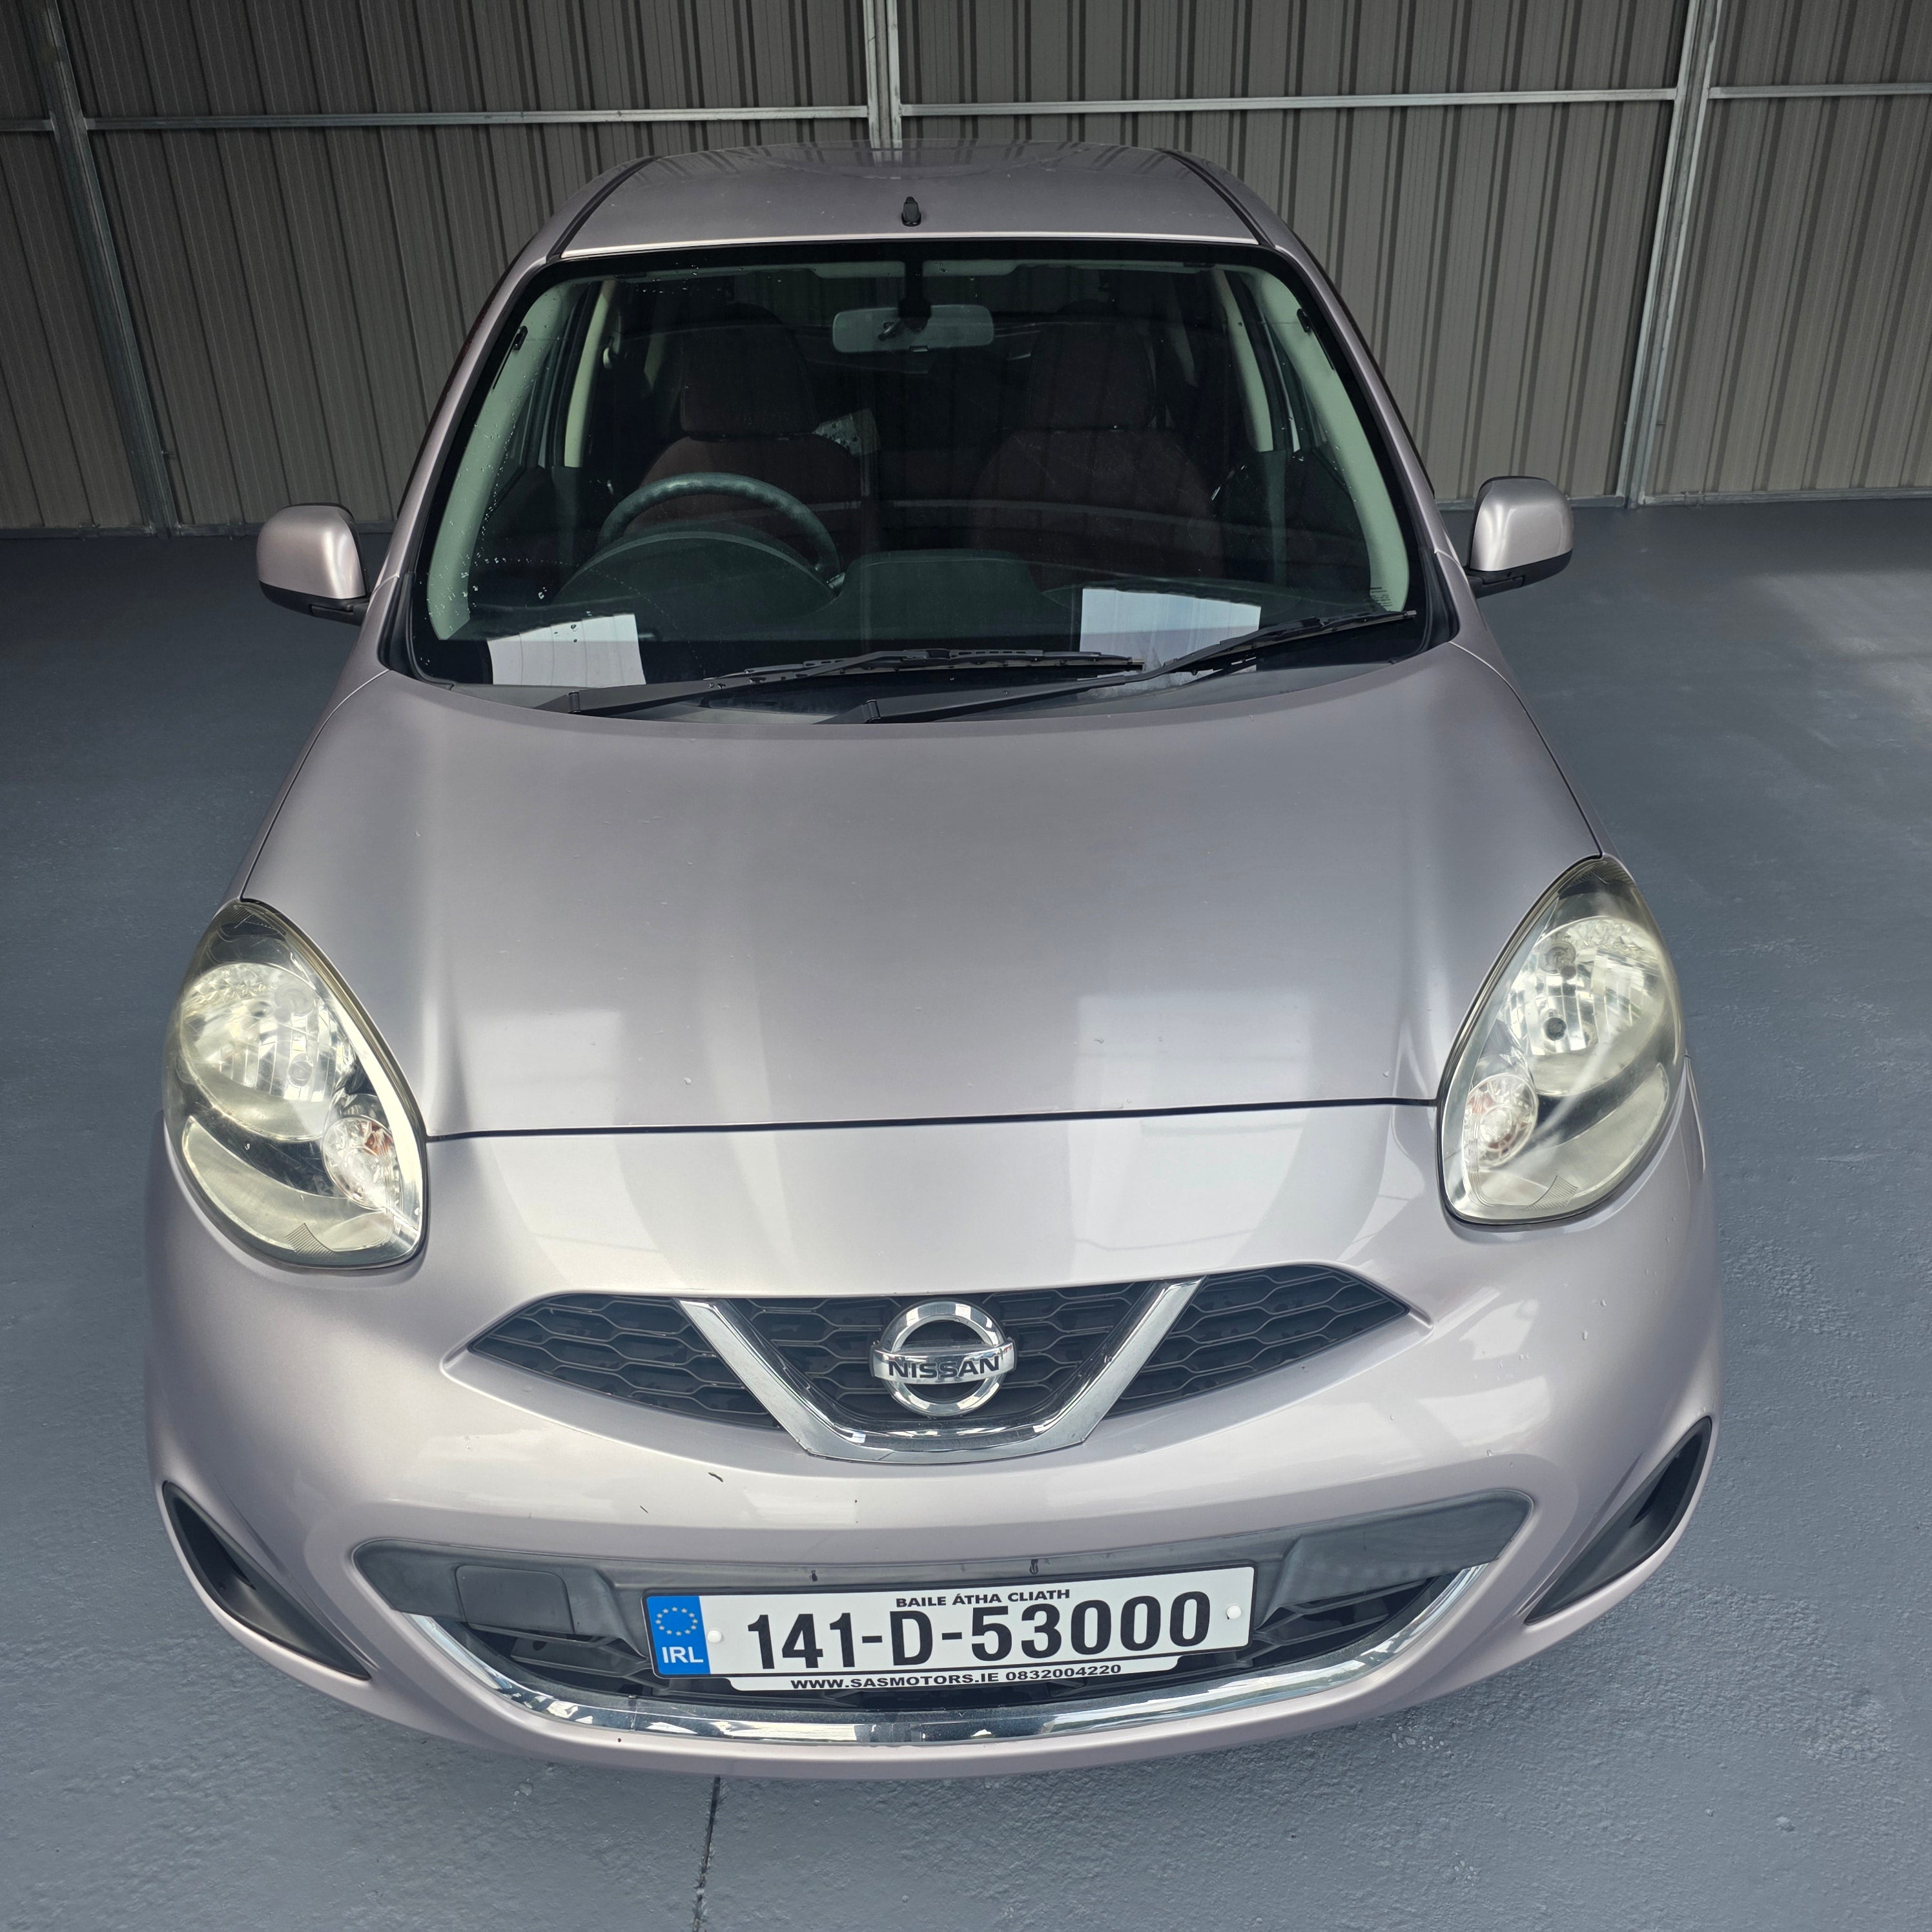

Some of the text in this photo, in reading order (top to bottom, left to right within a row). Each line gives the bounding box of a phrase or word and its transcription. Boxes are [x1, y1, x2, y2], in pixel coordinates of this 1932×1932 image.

[888, 1355, 1000, 1378] NISSAN
[896, 1589, 1070, 1608] BAILE ÁTHA CLIATH
[747, 1591, 1210, 1669] 141-D-53000
[661, 1646, 704, 1663] IRL
[790, 1664, 1122, 1689] WWW.SASMOTORS.IE 0832004220
